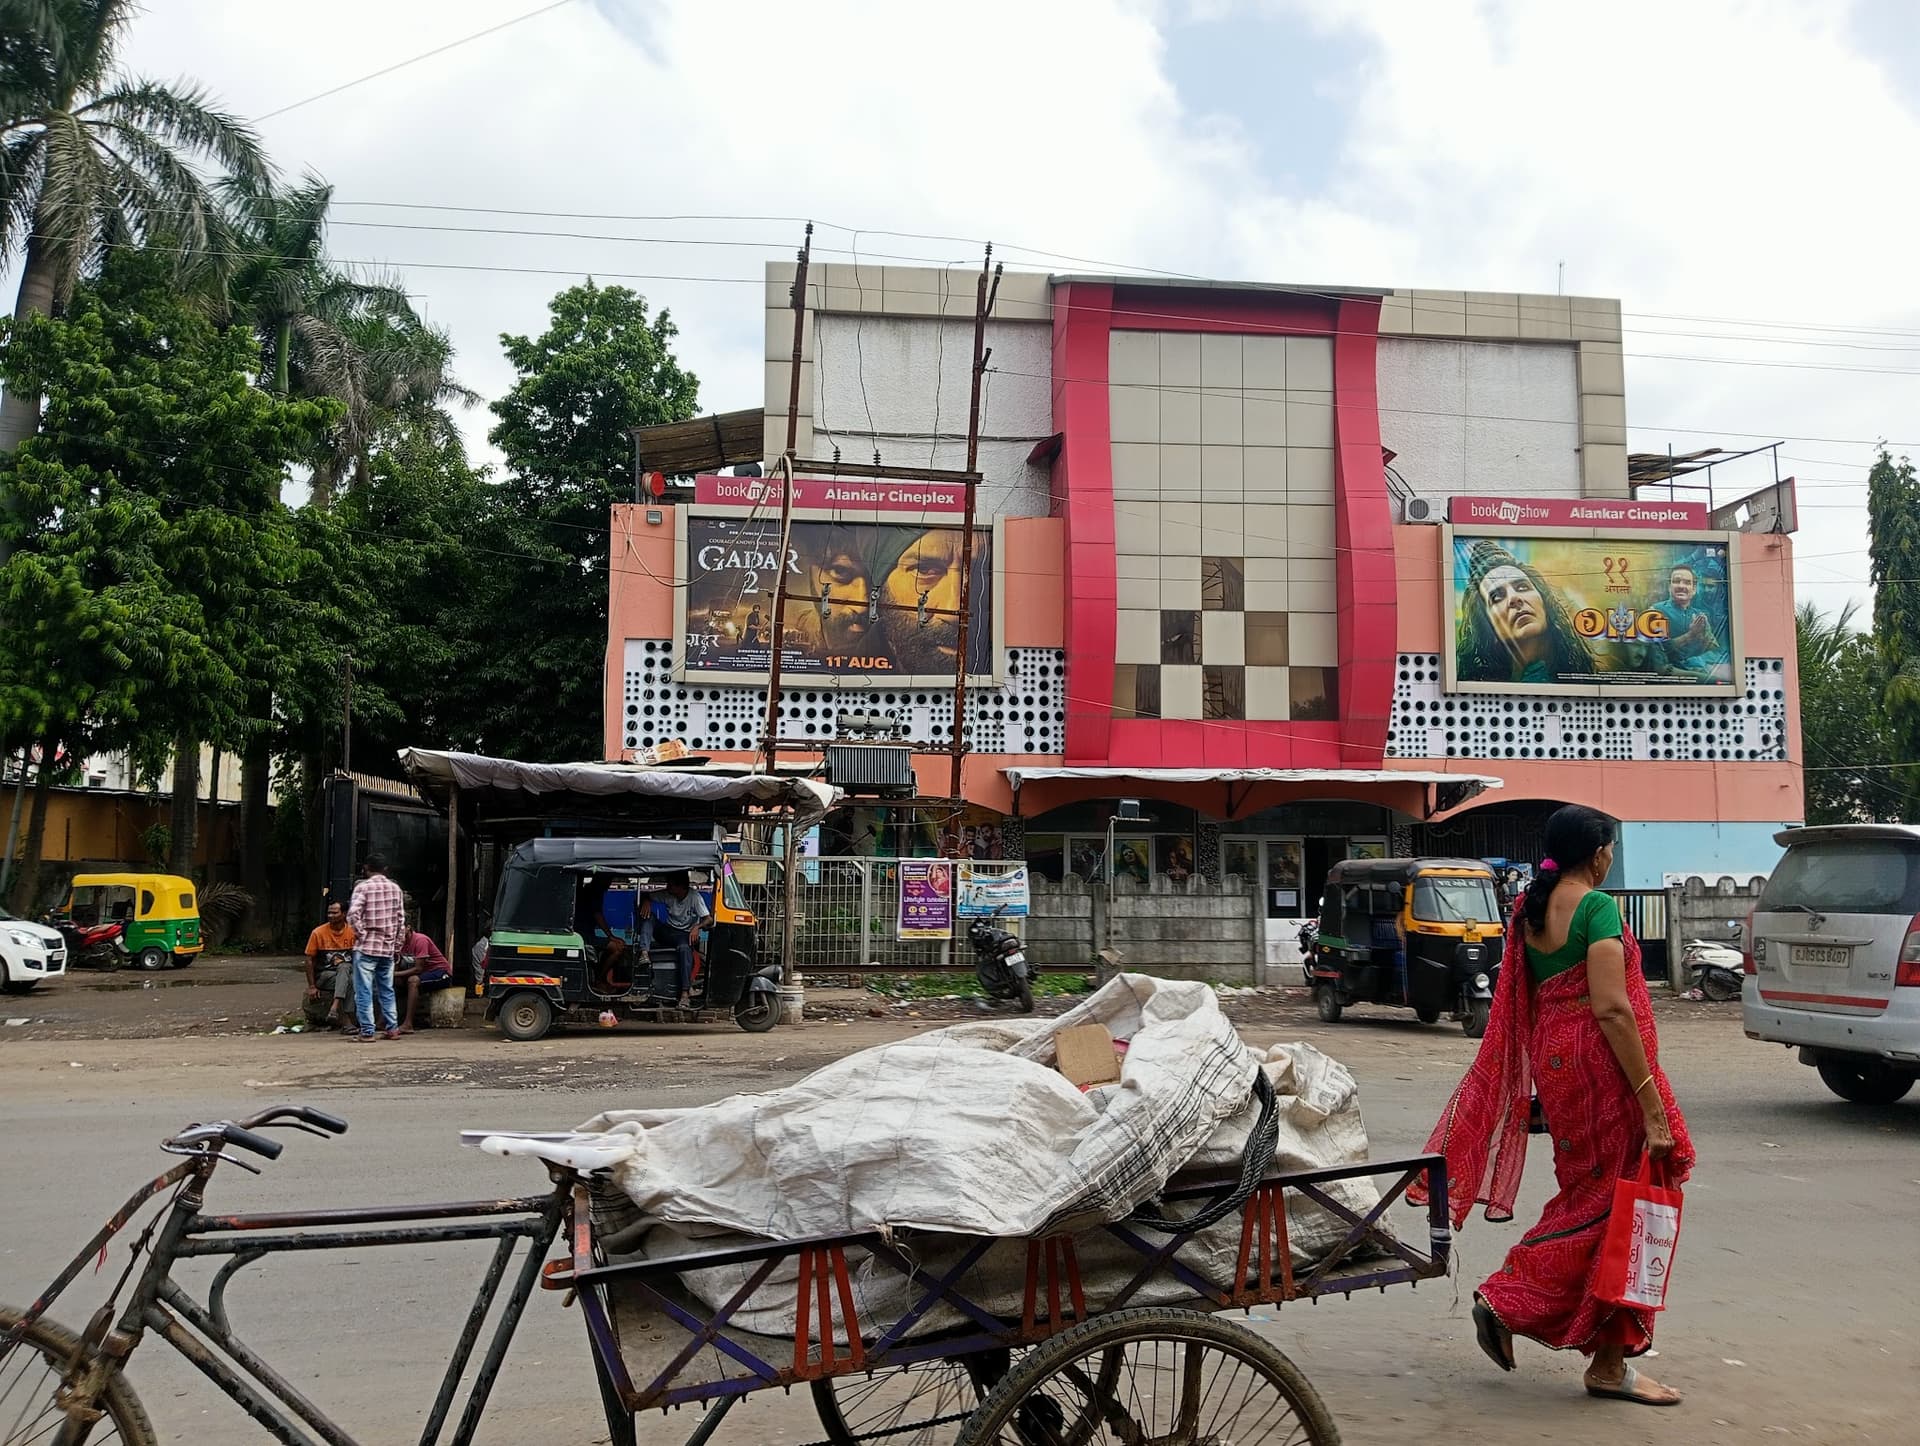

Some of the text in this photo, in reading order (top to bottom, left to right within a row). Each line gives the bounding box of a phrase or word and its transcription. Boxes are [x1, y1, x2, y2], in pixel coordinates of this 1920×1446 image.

[825, 487, 886, 502] Alankar
[888, 490, 956, 505] Cineplex
[1570, 506, 1626, 520] Alankar
[1627, 508, 1689, 522] Cineplex
[698, 545, 803, 574] GADAR
[743, 571, 759, 594] 2
[848, 656, 893, 669] AUG.
